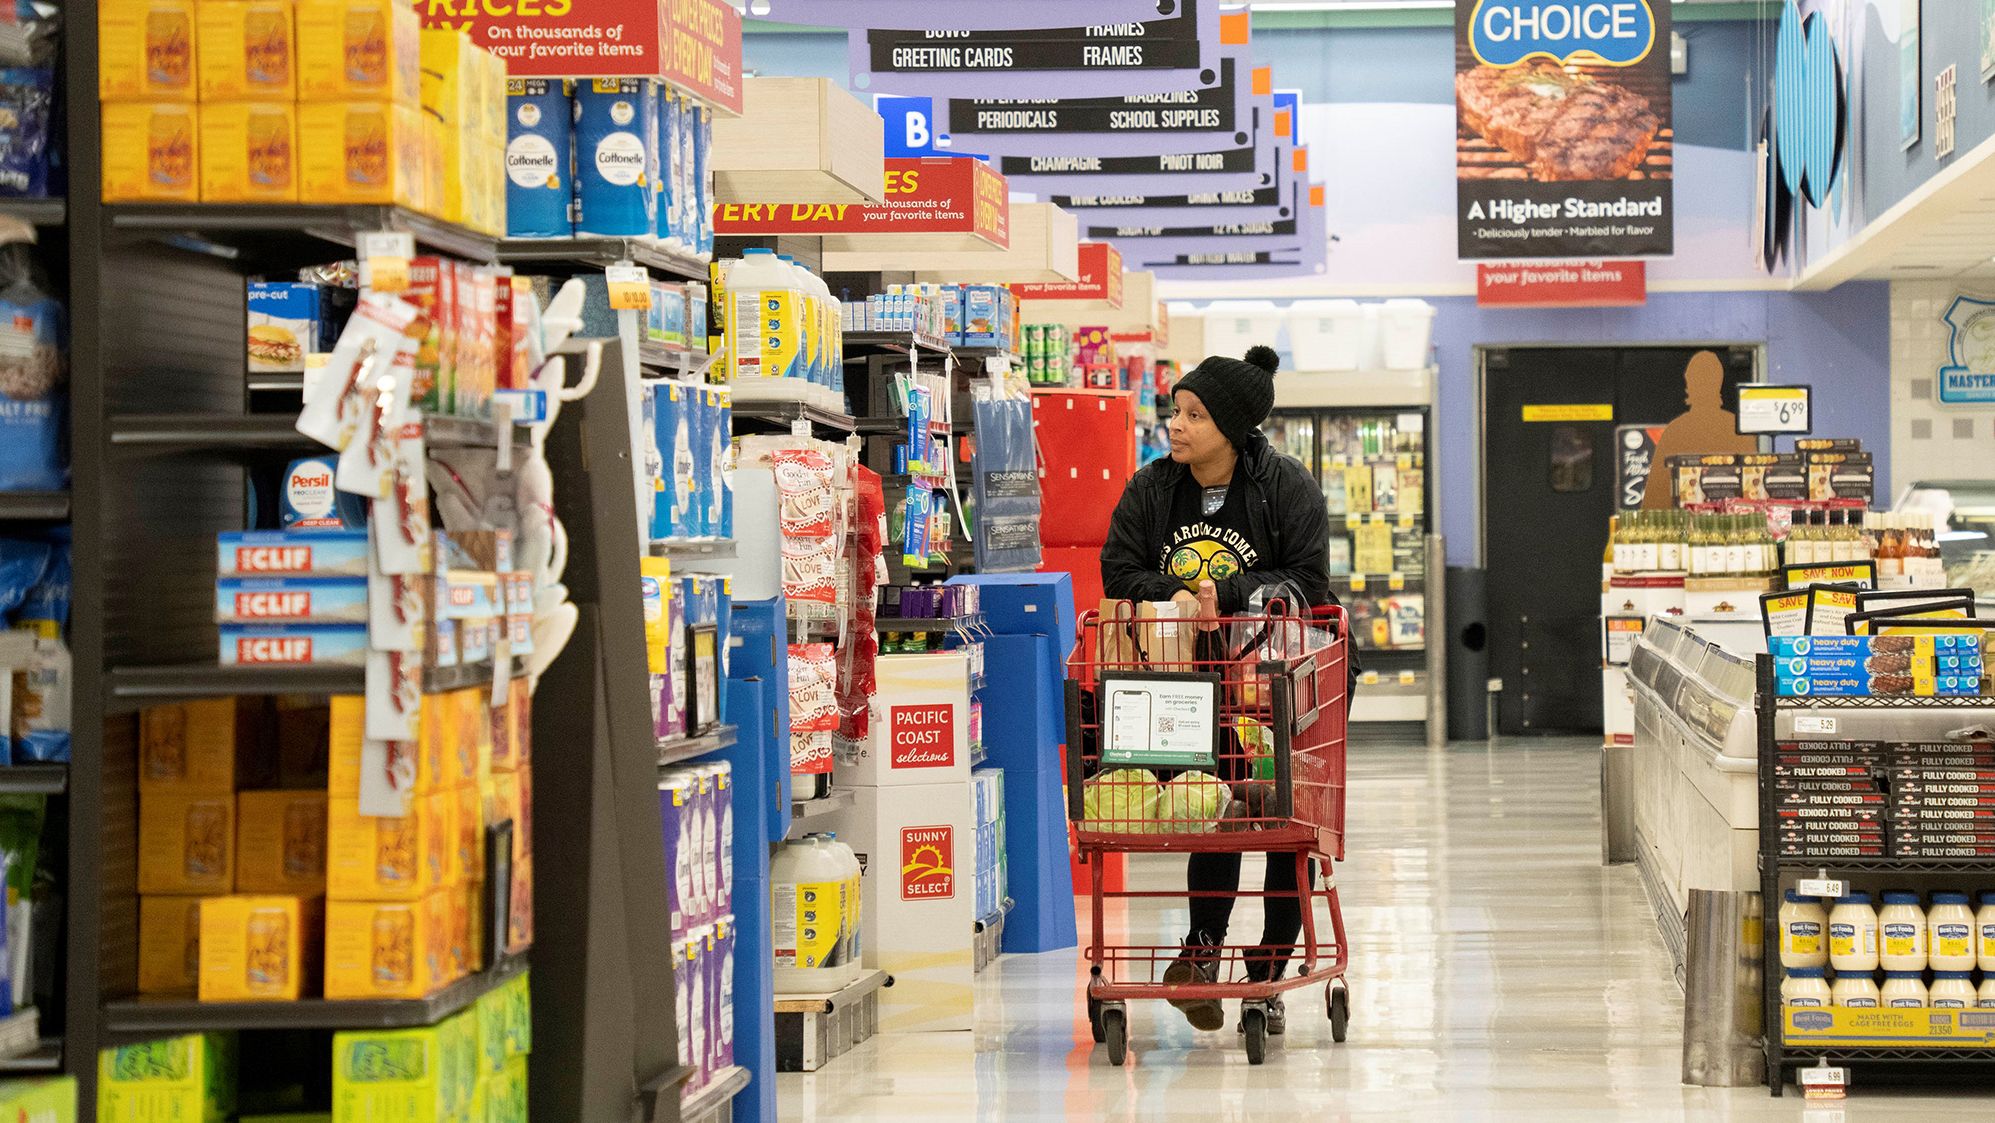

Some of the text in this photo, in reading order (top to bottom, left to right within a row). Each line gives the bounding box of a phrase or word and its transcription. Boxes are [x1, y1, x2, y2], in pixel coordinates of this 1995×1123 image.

[1483, 3, 1638, 42] CHOICE
[487, 26, 511, 39] On
[516, 25, 602, 40] thousands
[606, 24, 623, 40] of
[488, 42, 644, 59] your favorite items
[892, 45, 1143, 68] GREETING CARDS FRAMES
[507, 80, 523, 91] 24
[601, 77, 616, 88] 24
[977, 109, 1220, 129] PERIODICALS SCHOOL SUPPLIES
[905, 111, 930, 148] B
[508, 152, 643, 167] Cottonelle Cottonelle
[1030, 153, 1224, 172] CHAMPAGNE PINOT NOIR
[881, 198, 937, 209] thousands
[939, 198, 952, 210] of
[790, 204, 849, 222] DAY
[863, 210, 965, 222] your favorite items
[1467, 196, 1662, 225] A Higher Standard
[1477, 224, 1655, 240] Deliciously tender Marbled for flavor
[1485, 270, 1623, 287] your favorite items
[1023, 283, 1102, 292] your favorite items
[248, 290, 288, 301] pre-cut
[291, 474, 329, 488] Persil
[990, 472, 1035, 482] SENSATIONS
[990, 524, 1035, 535] SENSATIONS
[252, 548, 309, 571] CLIF
[799, 563, 822, 574] LOVE
[1831, 567, 1855, 578] NOW
[251, 593, 307, 616] CLIF
[1778, 597, 1804, 609] SAVE
[1813, 638, 1860, 648] heavy duty
[253, 638, 308, 662] CLIF
[1810, 658, 1856, 668] heavy duty
[1812, 678, 1859, 688] heavy duty
[896, 710, 949, 725] PACIFIC
[1820, 719, 1833, 730] 5.29
[896, 730, 941, 745] COAST
[896, 747, 949, 764] selections
[1794, 768, 1815, 776] FULLY
[1816, 768, 1847, 776] COOKED
[1923, 772, 1977, 780] FULLY COOKED
[1925, 785, 1979, 793] FULLY COOKED
[1809, 796, 1863, 804] FULLY COOKED
[1924, 798, 1978, 806] FULLY COOKED
[1920, 811, 1975, 819] FULLY COOKED
[1805, 822, 1859, 830] FULLY COOKED
[906, 831, 948, 843] SUNNY
[1806, 835, 1860, 843] FULLY COOKED
[1922, 835, 1977, 843] FULLY COOKED
[1806, 848, 1860, 856] FULLY COOKED
[1922, 848, 1976, 856] FULLY COOKED
[907, 882, 949, 895] SELECT
[1826, 883, 1840, 894] 6.49
[1872, 1020, 1891, 1028] FREE
[1928, 1025, 1953, 1035] 21350
